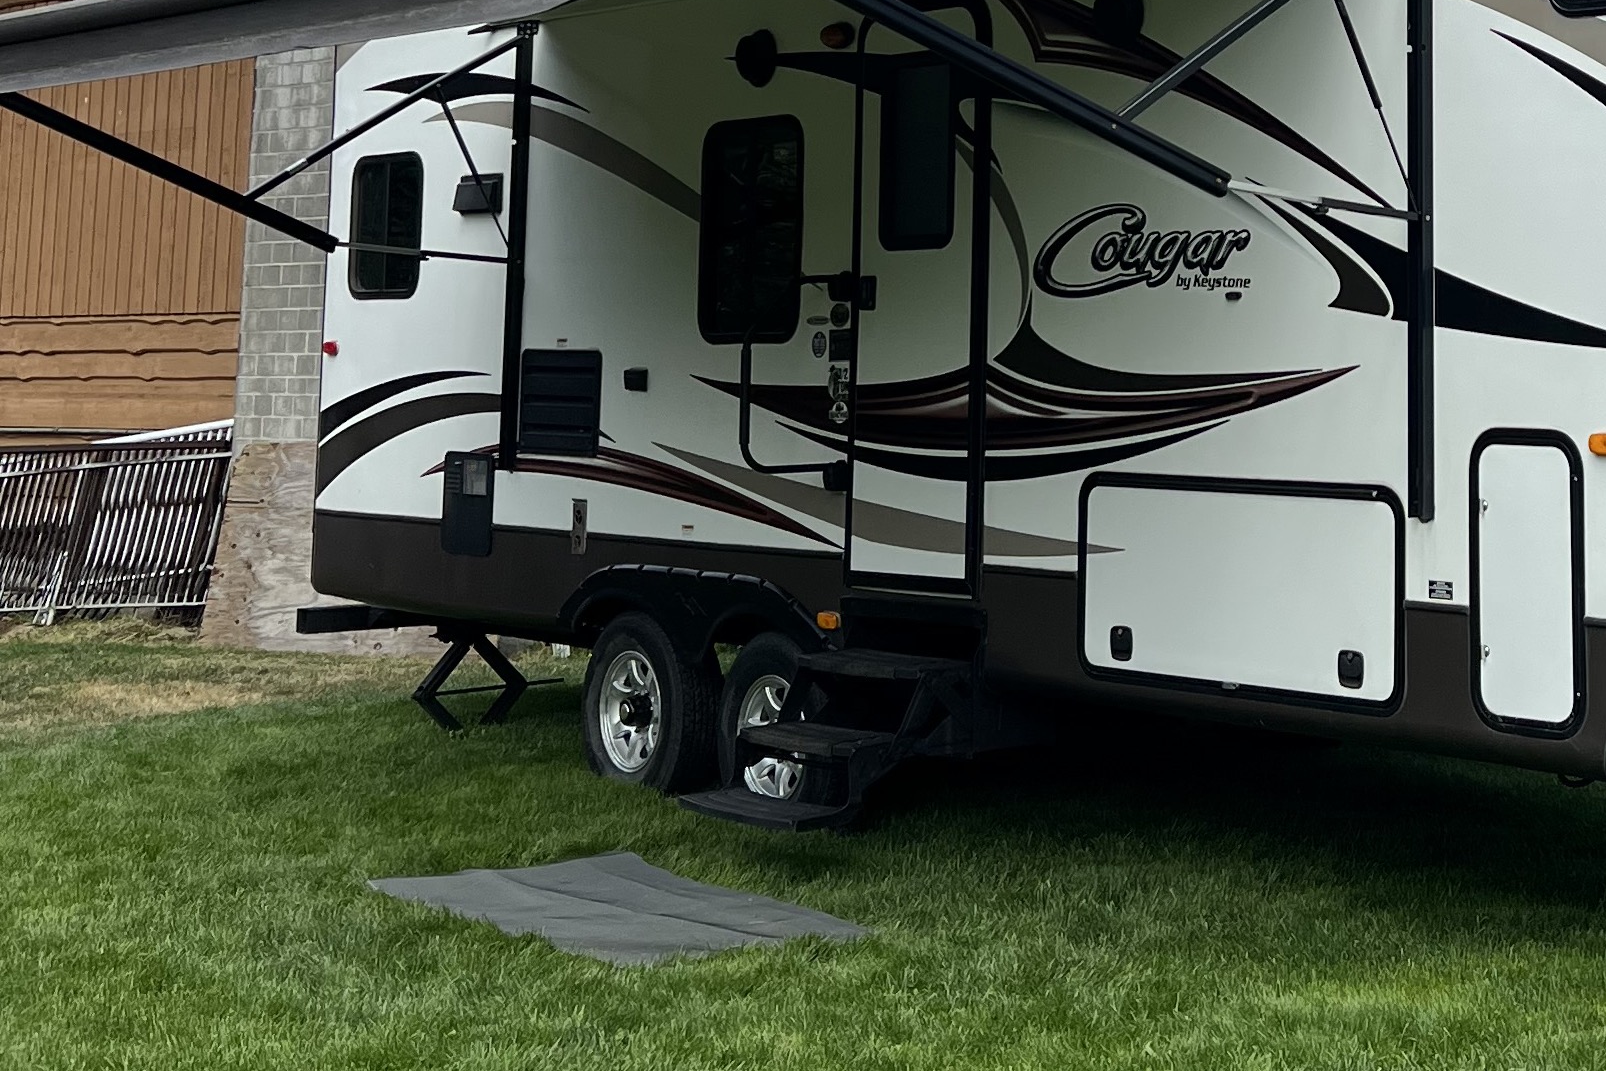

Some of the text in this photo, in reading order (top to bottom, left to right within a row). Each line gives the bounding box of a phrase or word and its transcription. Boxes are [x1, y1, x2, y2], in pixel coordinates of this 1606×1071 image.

[1033, 202, 1251, 299] Cougar
[1175, 273, 1251, 292] by Keystone
